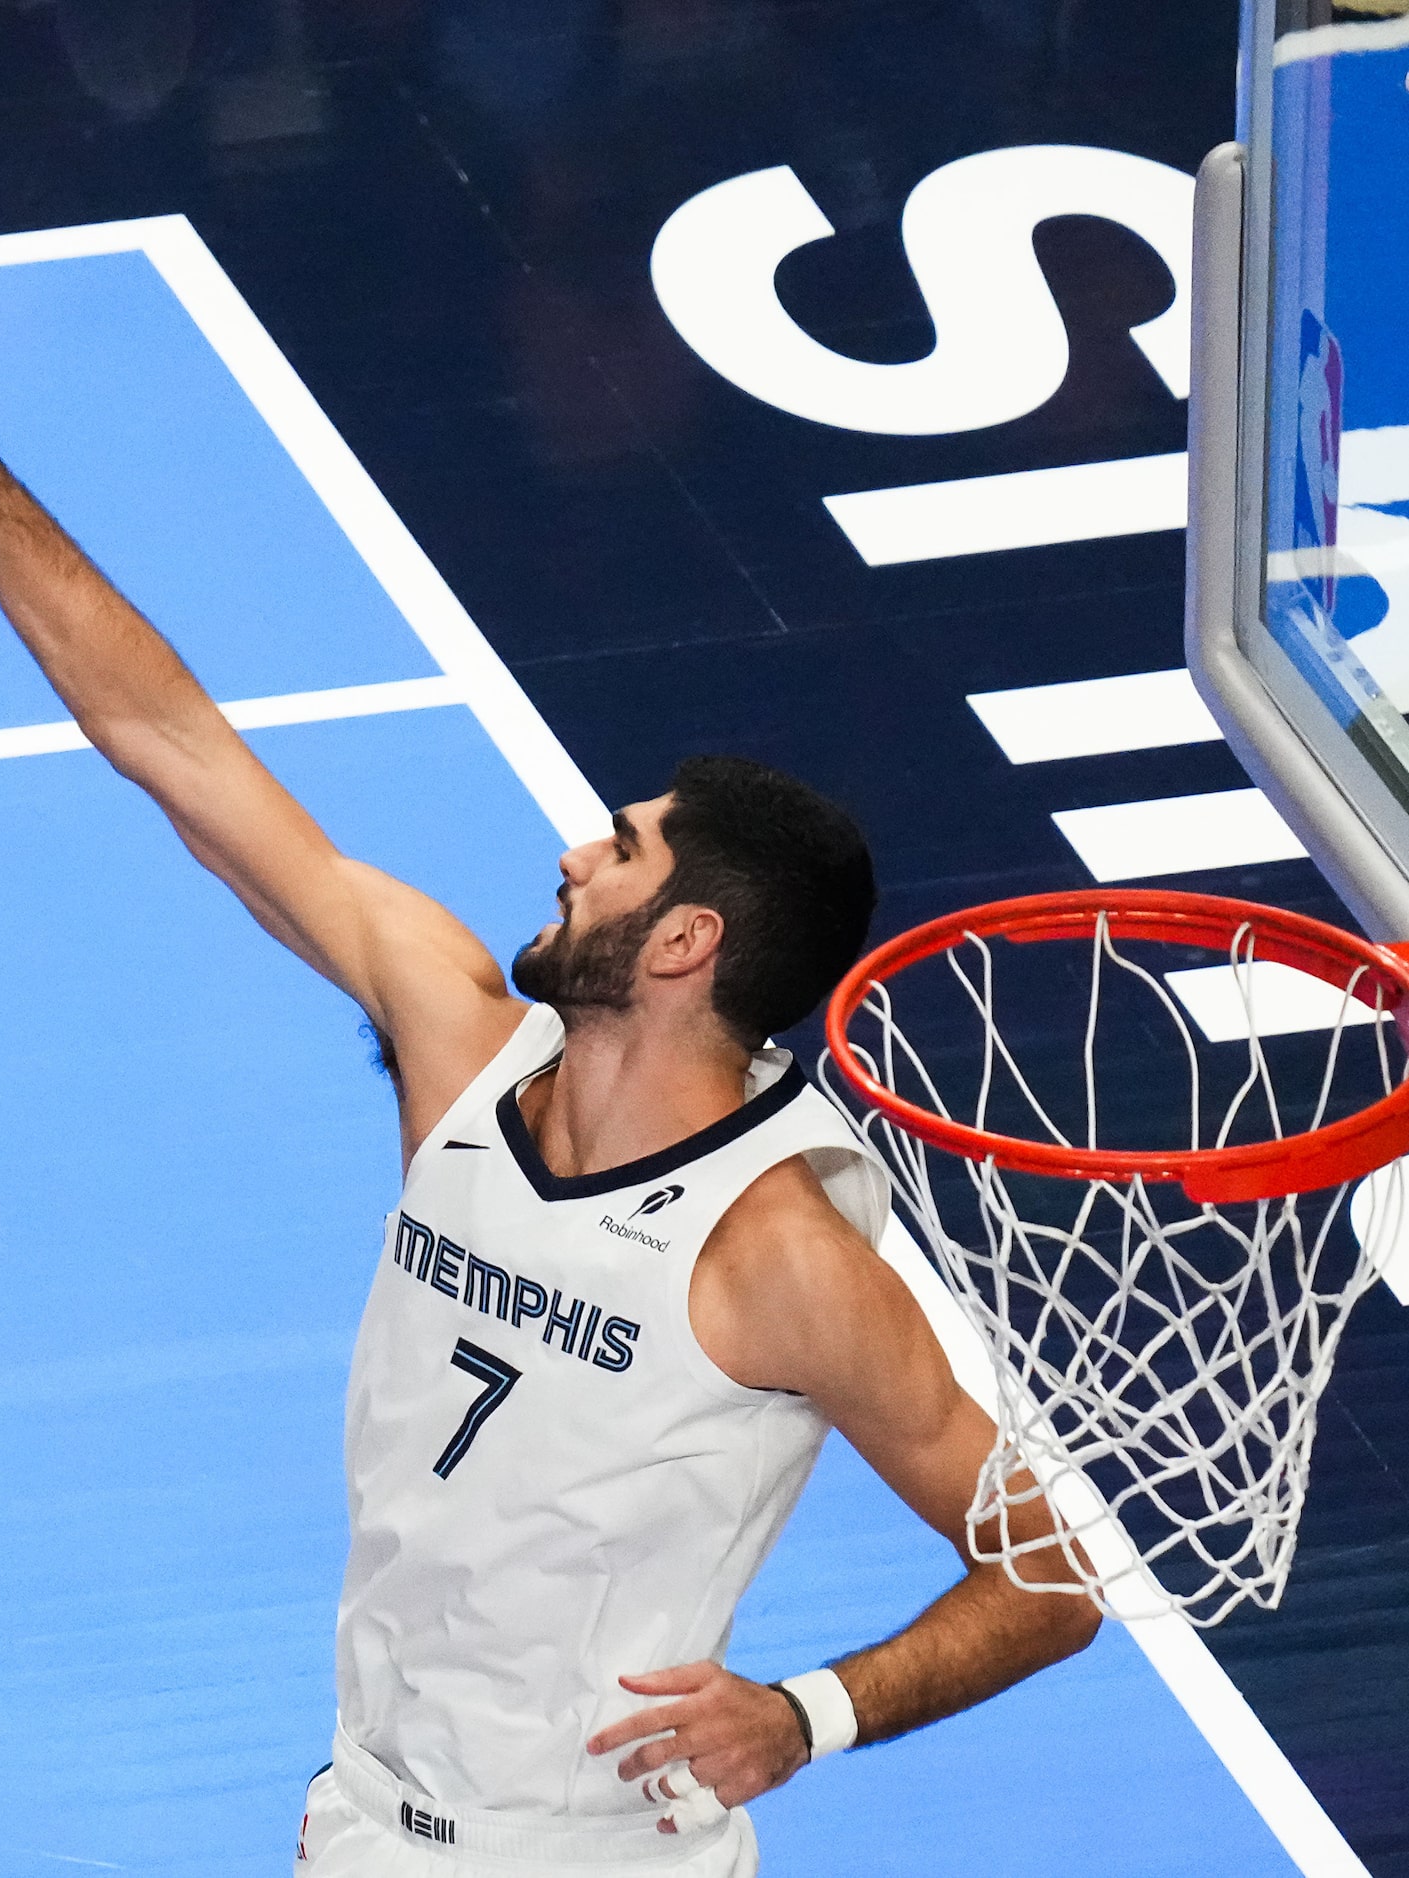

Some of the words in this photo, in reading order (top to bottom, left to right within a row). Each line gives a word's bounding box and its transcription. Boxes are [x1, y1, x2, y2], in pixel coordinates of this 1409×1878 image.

[394, 1210, 641, 1373] MEMPHIS
[599, 1215, 671, 1254] Robinhood
[432, 1337, 523, 1480] 7
